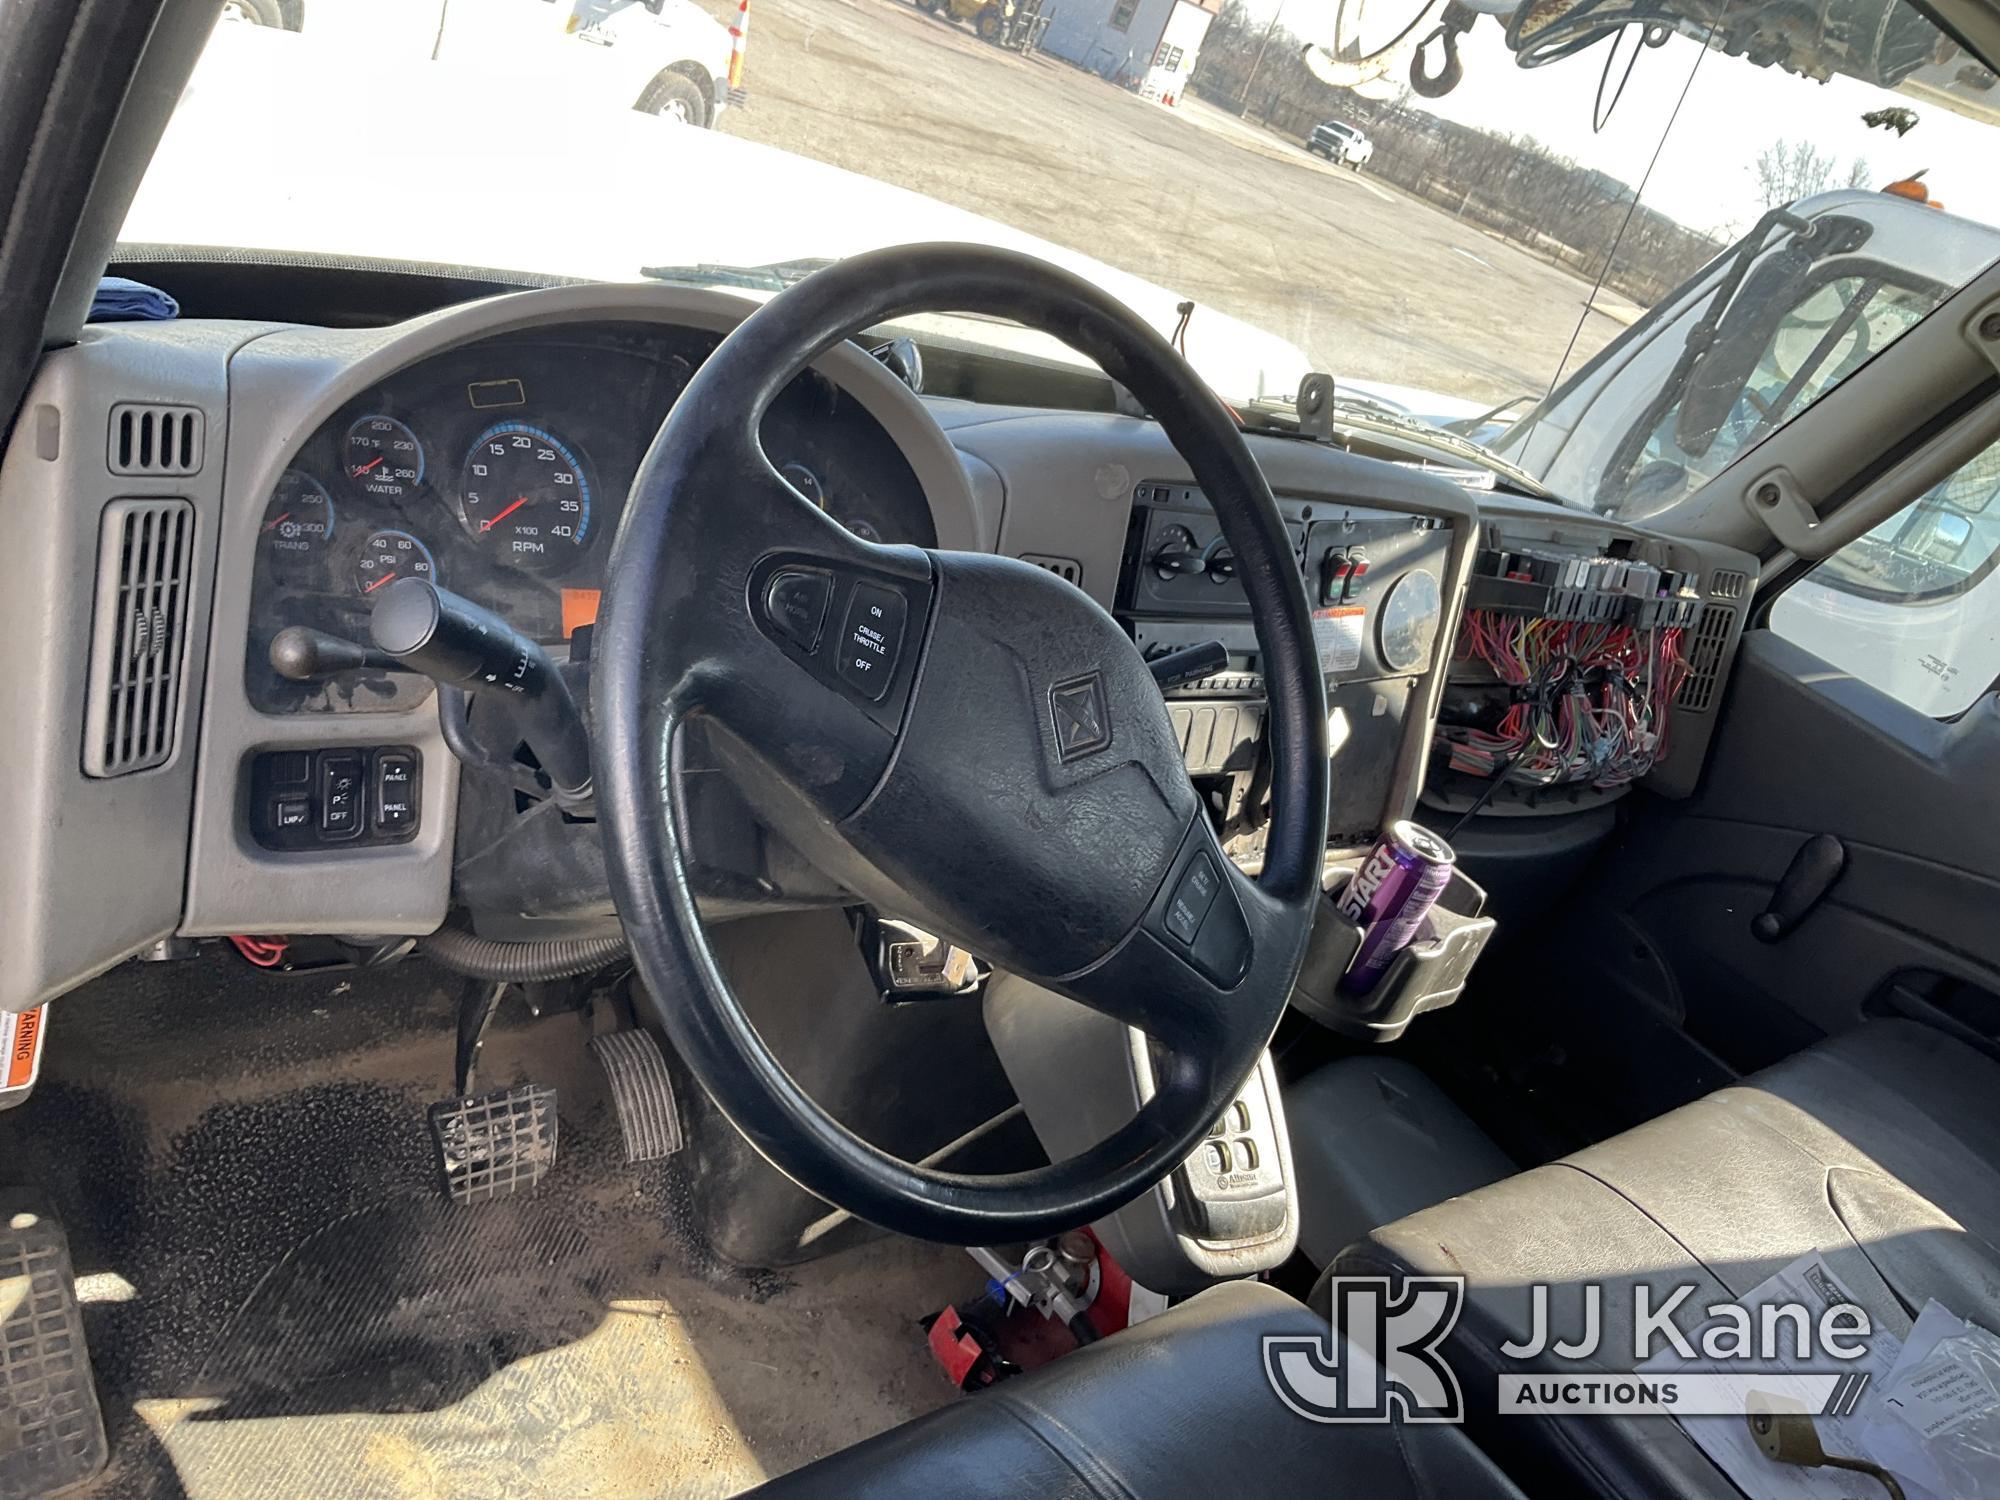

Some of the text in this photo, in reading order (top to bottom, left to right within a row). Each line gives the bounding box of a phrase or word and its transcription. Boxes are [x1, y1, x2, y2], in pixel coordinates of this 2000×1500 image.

[352, 436, 369, 446] 170
[393, 441, 414, 451] 230
[512, 436, 531, 448] 20
[490, 444, 504, 455] 15
[537, 449, 555, 461] 25
[395, 469, 415, 479] 260
[472, 465, 487, 476] 10
[554, 473, 573, 484] 30
[367, 485, 402, 495] WATER
[302, 494, 323, 504] 250
[468, 493, 479, 503] 5
[560, 501, 579, 511] 35
[515, 526, 538, 535] X100
[551, 526, 571, 537] 40
[373, 540, 387, 548] 40
[398, 541, 412, 549] 60
[512, 541, 544, 553] RPM
[380, 555, 396, 563] PSI
[360, 560, 374, 569] 20
[414, 562, 428, 571] 80
[871, 606, 882, 618] ON
[853, 633, 886, 654] THROTTLE
[855, 658, 872, 671] OFF
[331, 812, 348, 820] OFF
